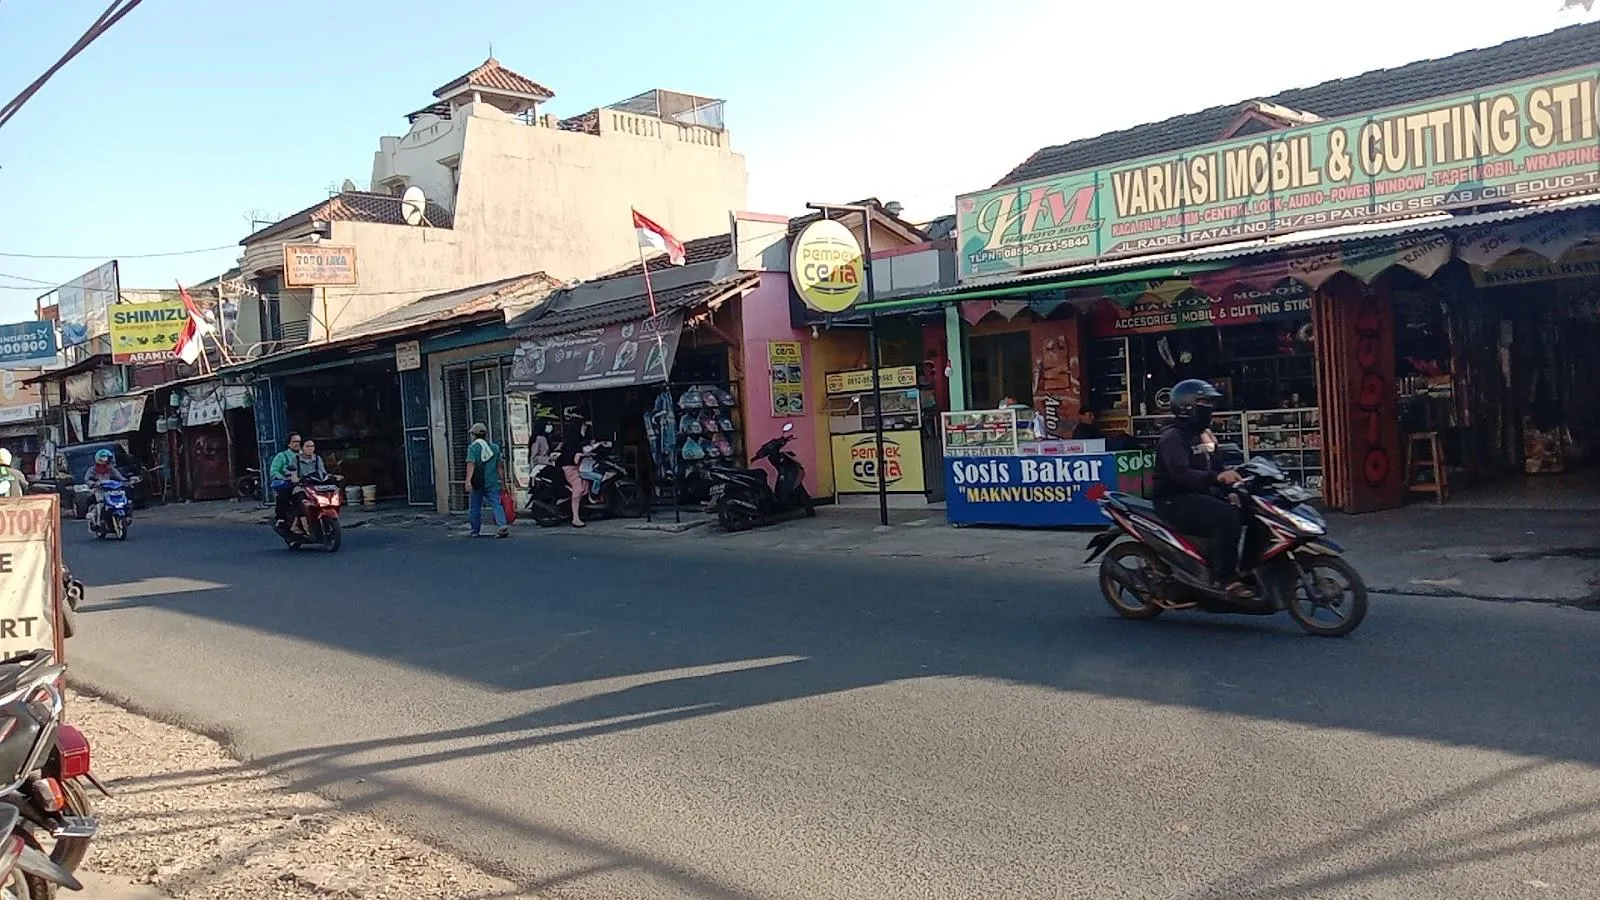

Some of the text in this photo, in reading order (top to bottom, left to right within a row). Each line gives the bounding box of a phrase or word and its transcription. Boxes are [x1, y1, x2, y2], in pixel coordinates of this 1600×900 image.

[1113, 81, 1600, 217] VARIASI MOBIL & CUTTING STI
[1374, 174, 1425, 195] WINDOW
[1191, 227, 1241, 242] FATAH
[1243, 221, 1267, 233] NO
[1331, 201, 1407, 221] PARUNG
[1408, 190, 1472, 209] SERAB
[114, 308, 188, 324] SHIMIZU
[1114, 313, 1178, 330] ACCESORIES
[1182, 310, 1216, 322] MOBIL
[1231, 303, 1280, 317] CUTTING
[952, 459, 1010, 484] Sosis
[1020, 458, 1103, 484] Bakar
